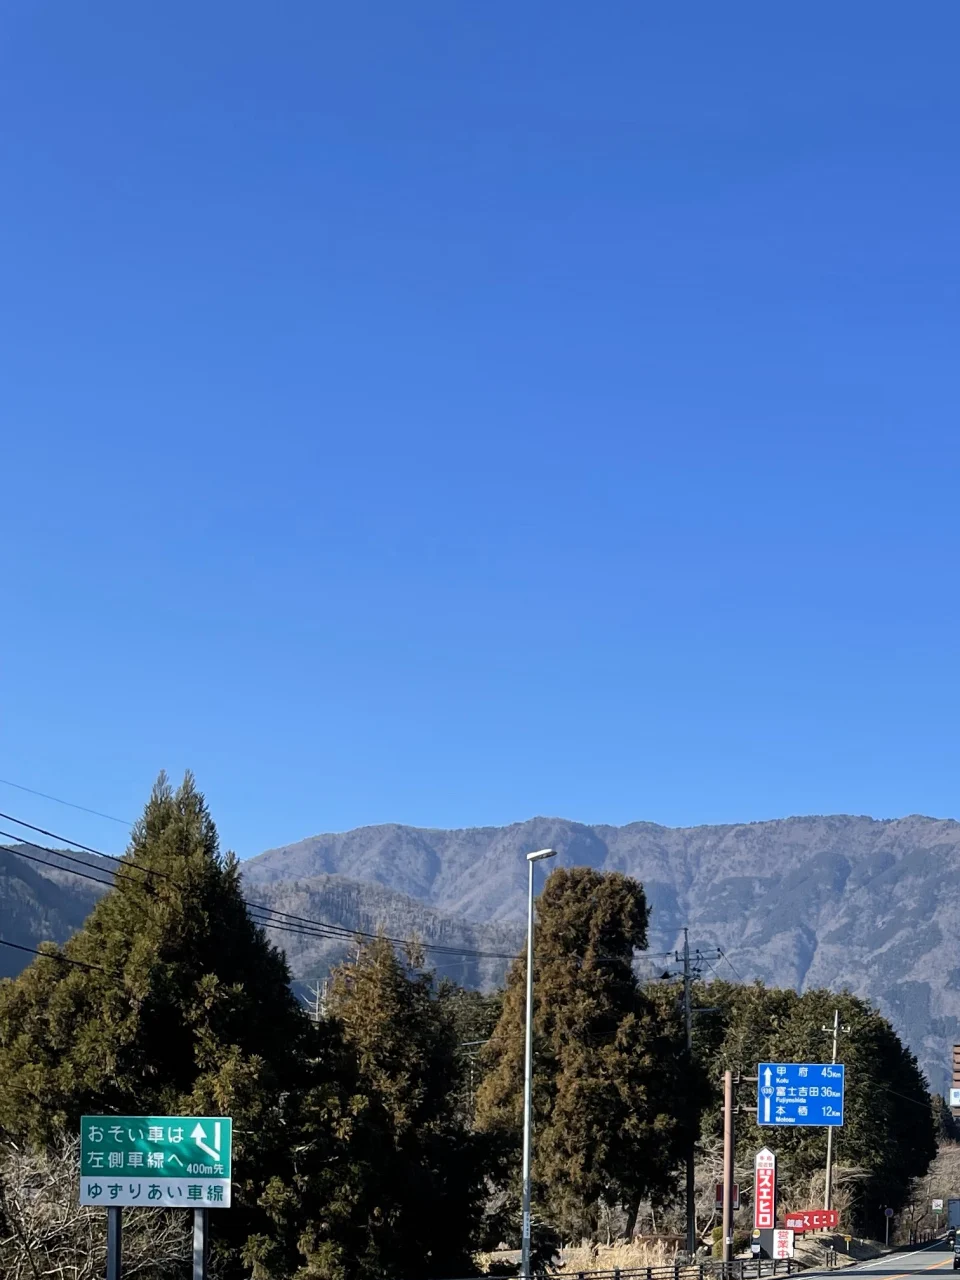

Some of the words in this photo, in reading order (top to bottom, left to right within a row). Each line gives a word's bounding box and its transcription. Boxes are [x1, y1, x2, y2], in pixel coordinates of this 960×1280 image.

[776, 1066, 808, 1077] 甲府
[776, 1086, 819, 1097] 富士吉田
[88, 1126, 184, 1143] おそい車は
[87, 1151, 184, 1169] 左側車線へ
[187, 1164, 224, 1174] 400m先
[88, 1183, 224, 1201] ゆずりあい車線
[759, 1175, 771, 1225] スエヒロ
[777, 1230, 789, 1259] 営業中
